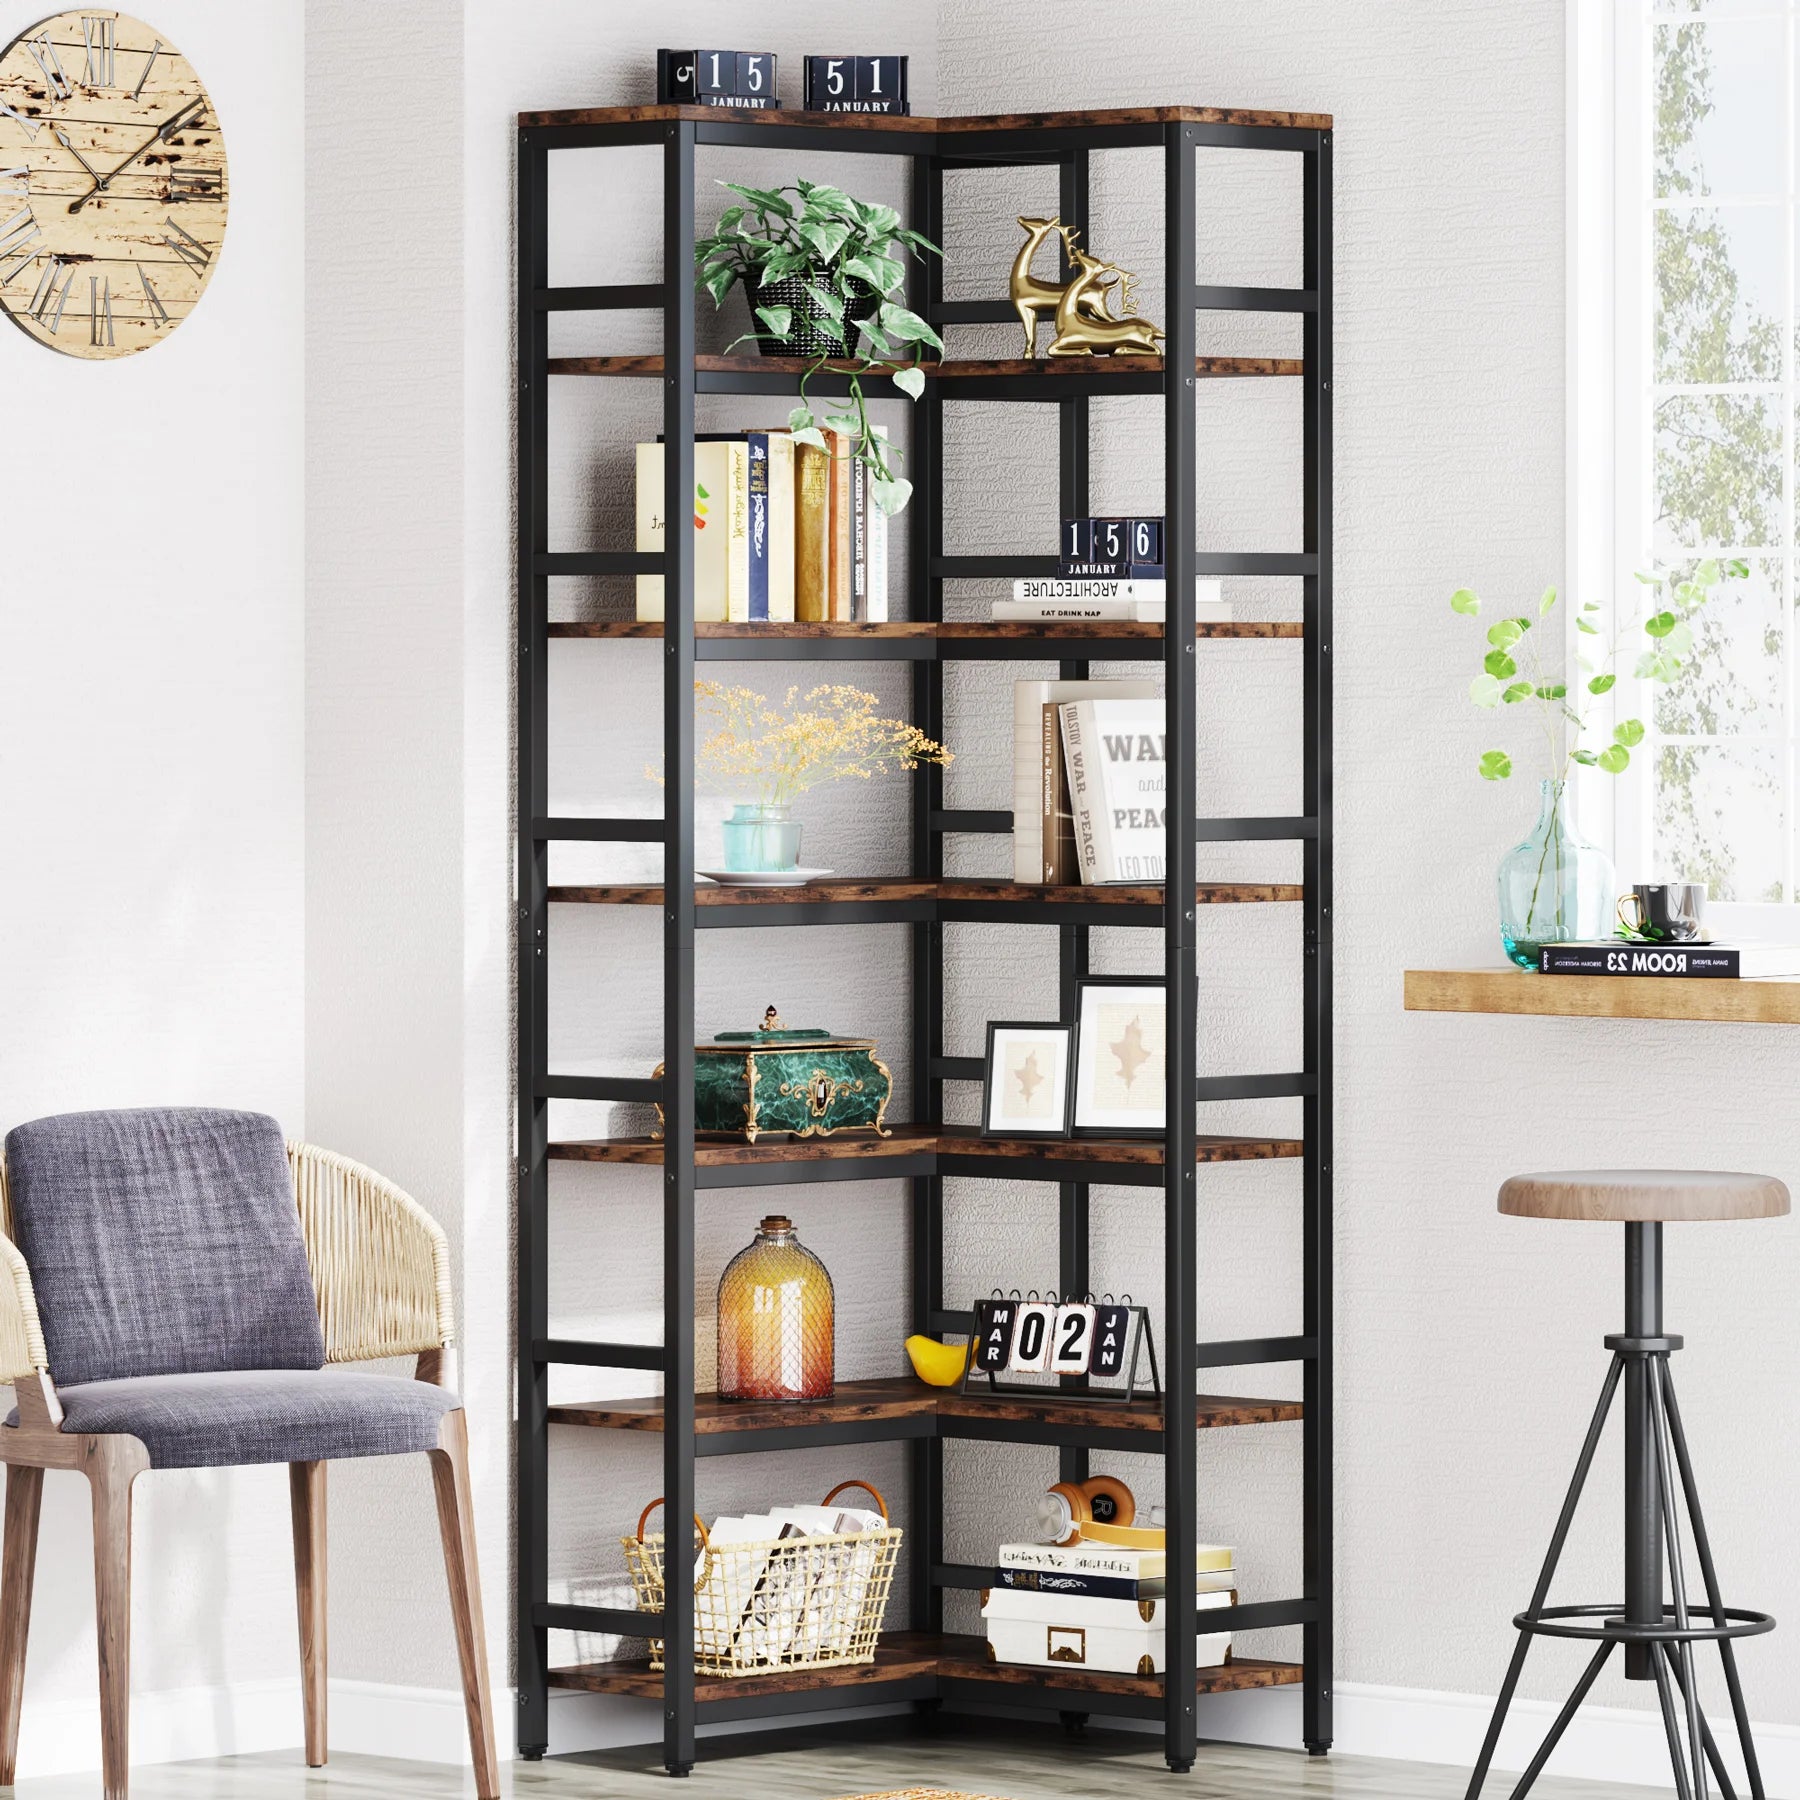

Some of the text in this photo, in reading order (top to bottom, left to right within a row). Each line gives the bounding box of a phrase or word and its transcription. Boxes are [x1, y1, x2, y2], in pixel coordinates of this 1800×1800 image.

[710, 97, 766, 108] JANUARY
[823, 102, 890, 112] JANUARY
[1068, 564, 1116, 575] JANUARY
[1023, 582, 1119, 597] ARCHITECTURE
[1044, 712, 1052, 755] REVEALING
[1065, 705, 1082, 746] TOLSTOY
[1102, 734, 1166, 762] WA
[1072, 751, 1087, 795] WAR
[1044, 768, 1053, 816] Revolution
[1080, 809, 1097, 867] PEACE
[1118, 855, 1141, 880] LEO
